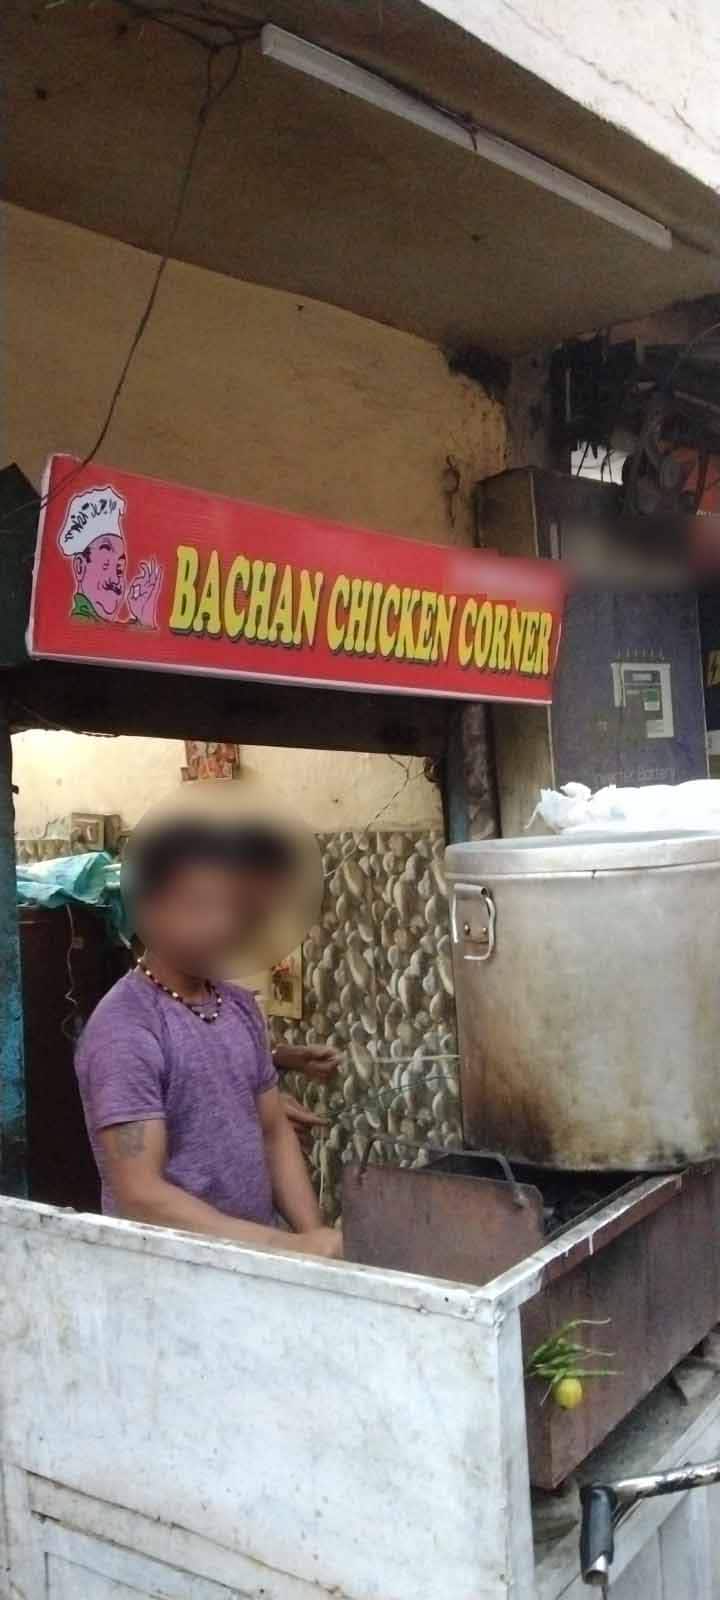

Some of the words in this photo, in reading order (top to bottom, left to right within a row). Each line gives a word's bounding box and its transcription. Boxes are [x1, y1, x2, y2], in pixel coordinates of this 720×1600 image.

[169, 545, 324, 647] BACHAN
[327, 574, 456, 663] CHICKEN
[458, 598, 553, 676] CORNER
